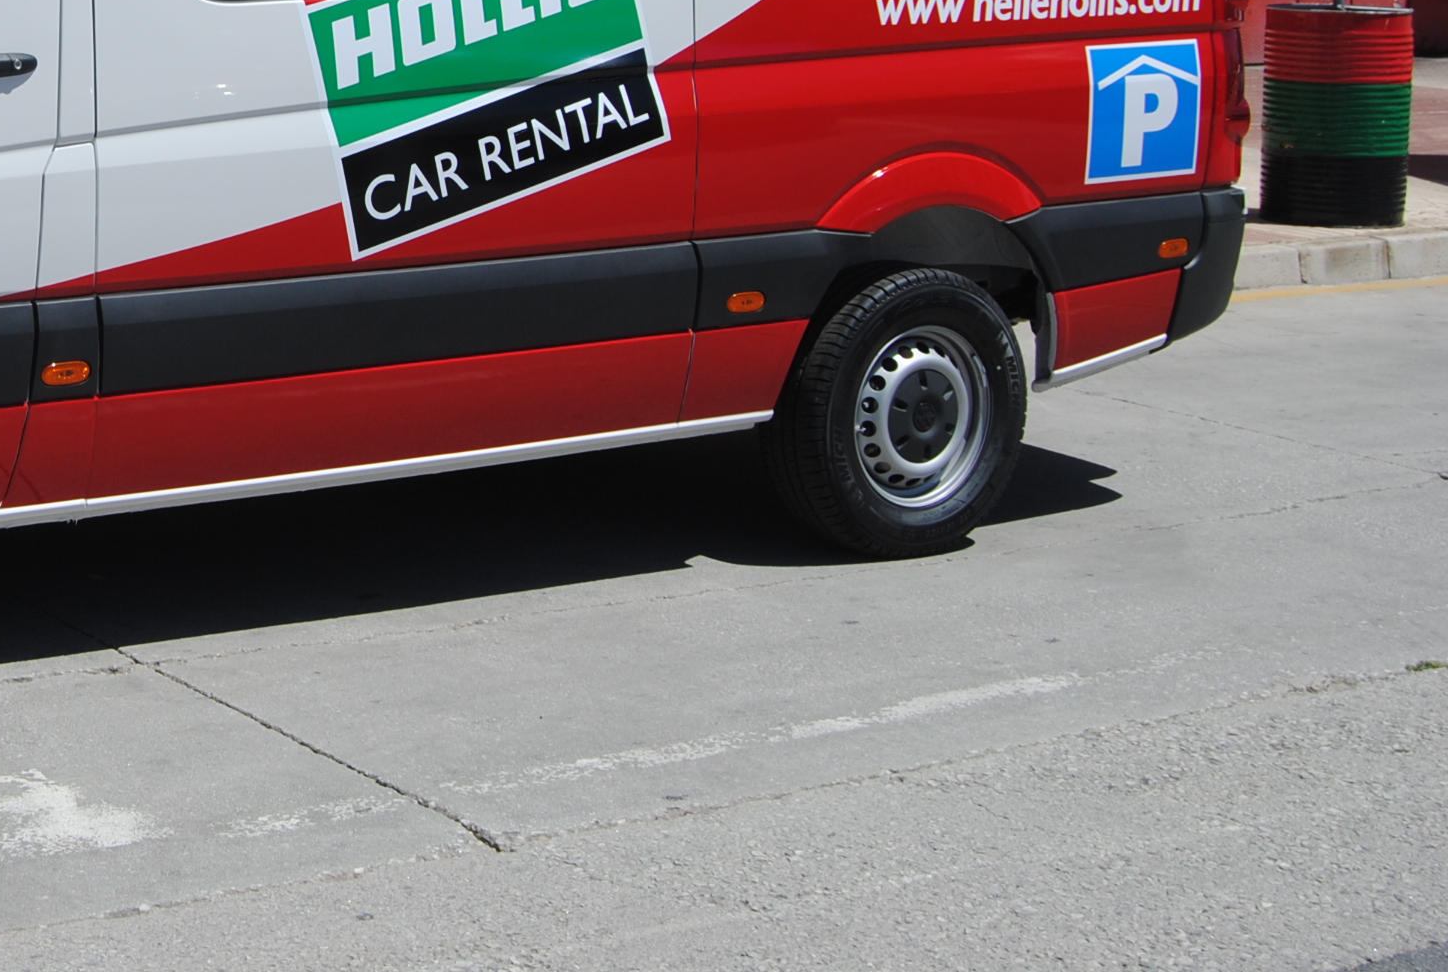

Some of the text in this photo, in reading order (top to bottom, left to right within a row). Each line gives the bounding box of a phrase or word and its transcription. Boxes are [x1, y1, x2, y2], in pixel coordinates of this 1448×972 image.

[363, 83, 650, 221] CAR RENTAL
[1120, 72, 1179, 168] P
